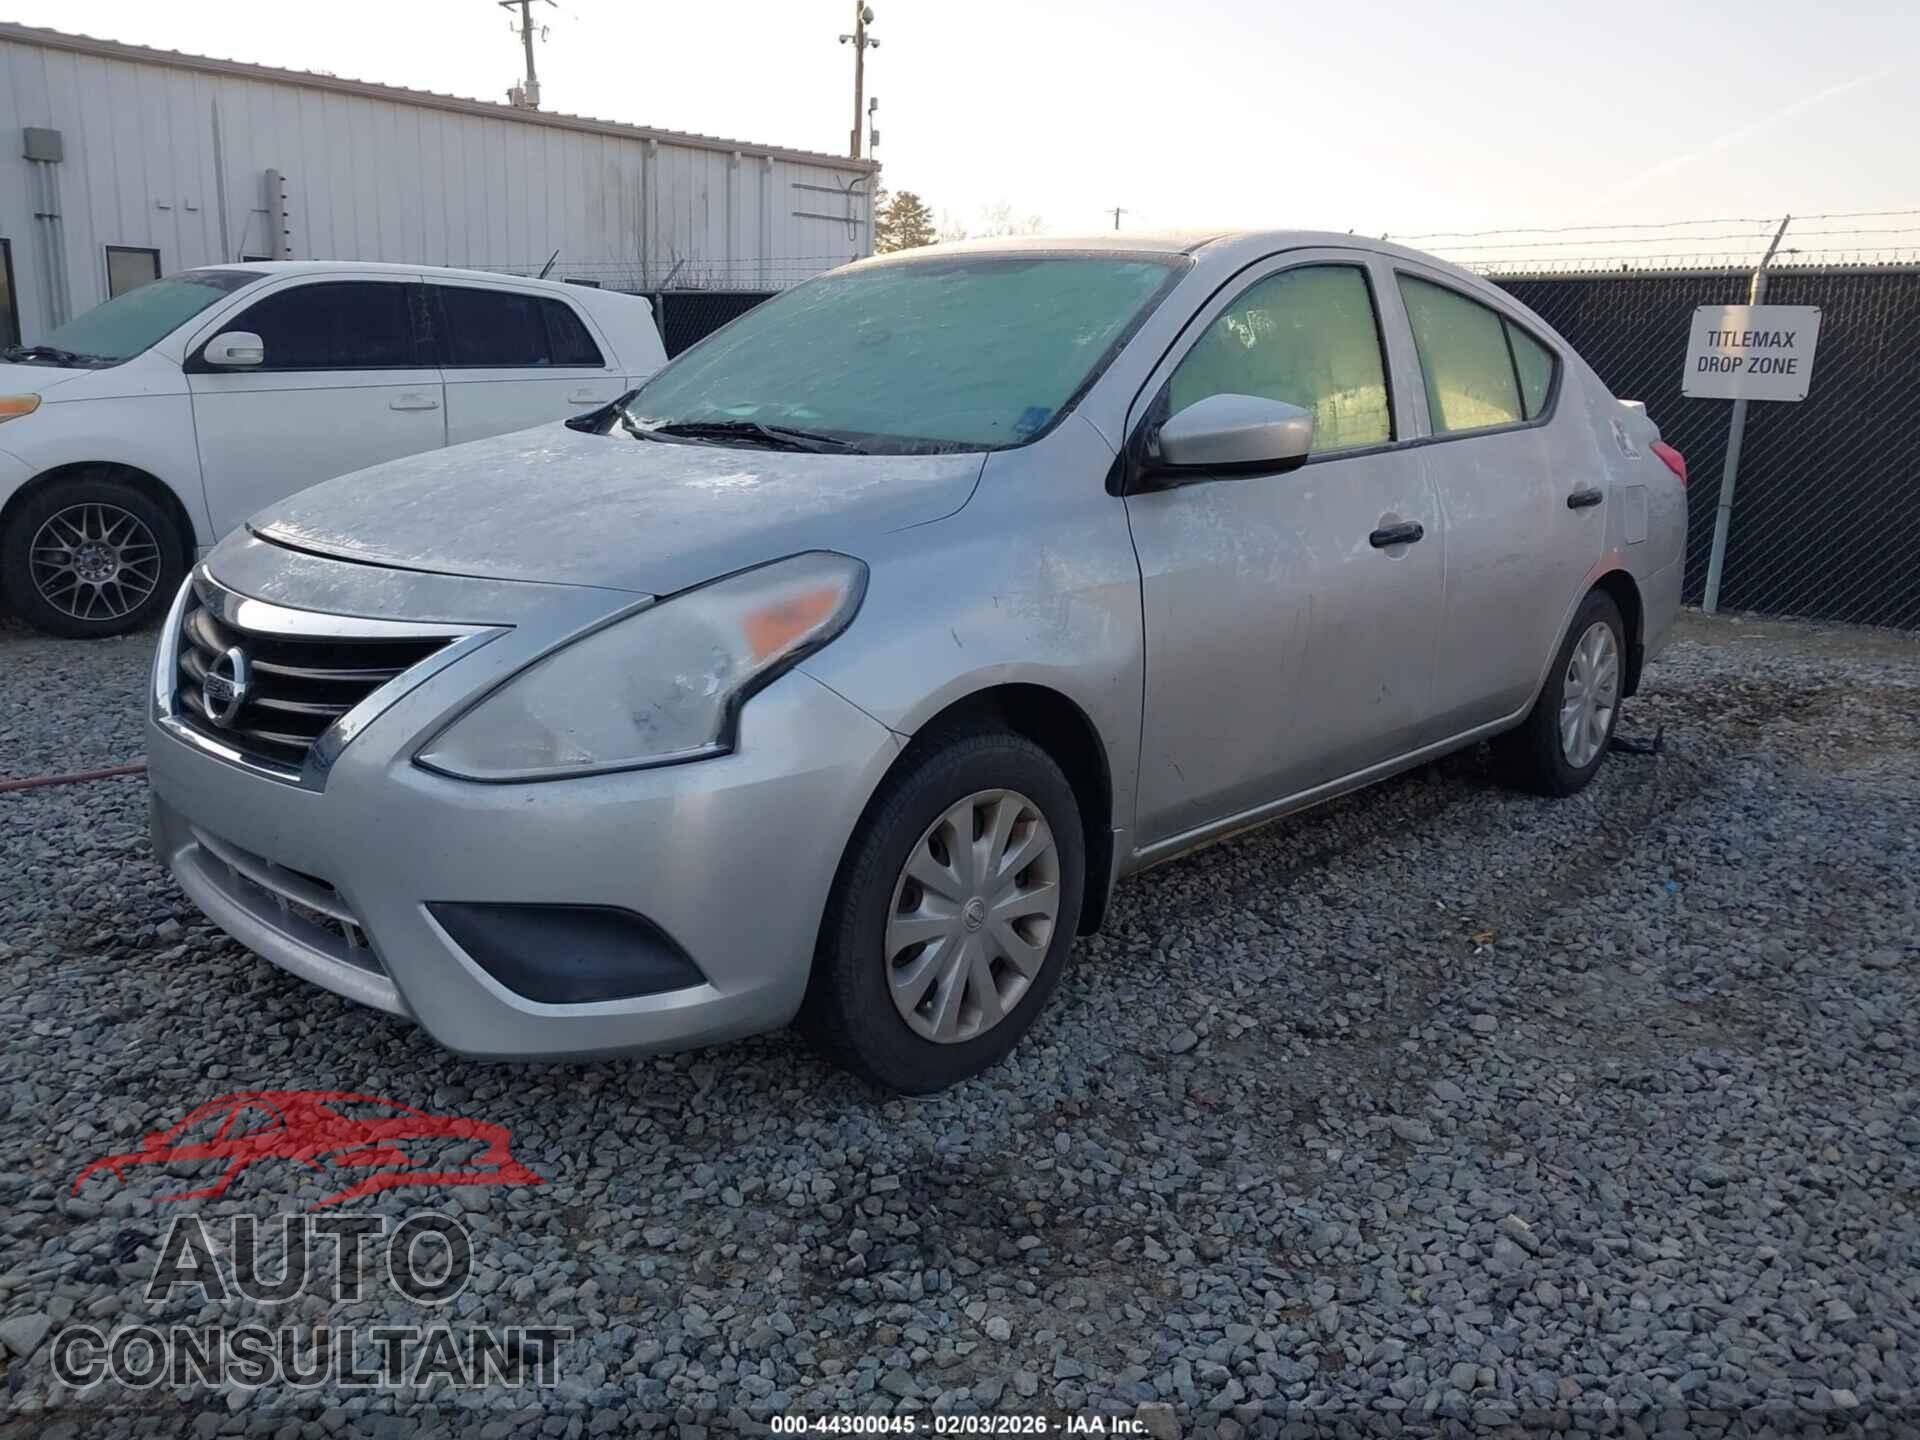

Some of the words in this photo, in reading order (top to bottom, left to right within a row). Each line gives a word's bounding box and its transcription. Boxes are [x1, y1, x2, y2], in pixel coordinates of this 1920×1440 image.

[1708, 331, 1796, 348] TITLEMAX
[1697, 356, 1743, 373] DROP
[1748, 358, 1798, 374] ZONE
